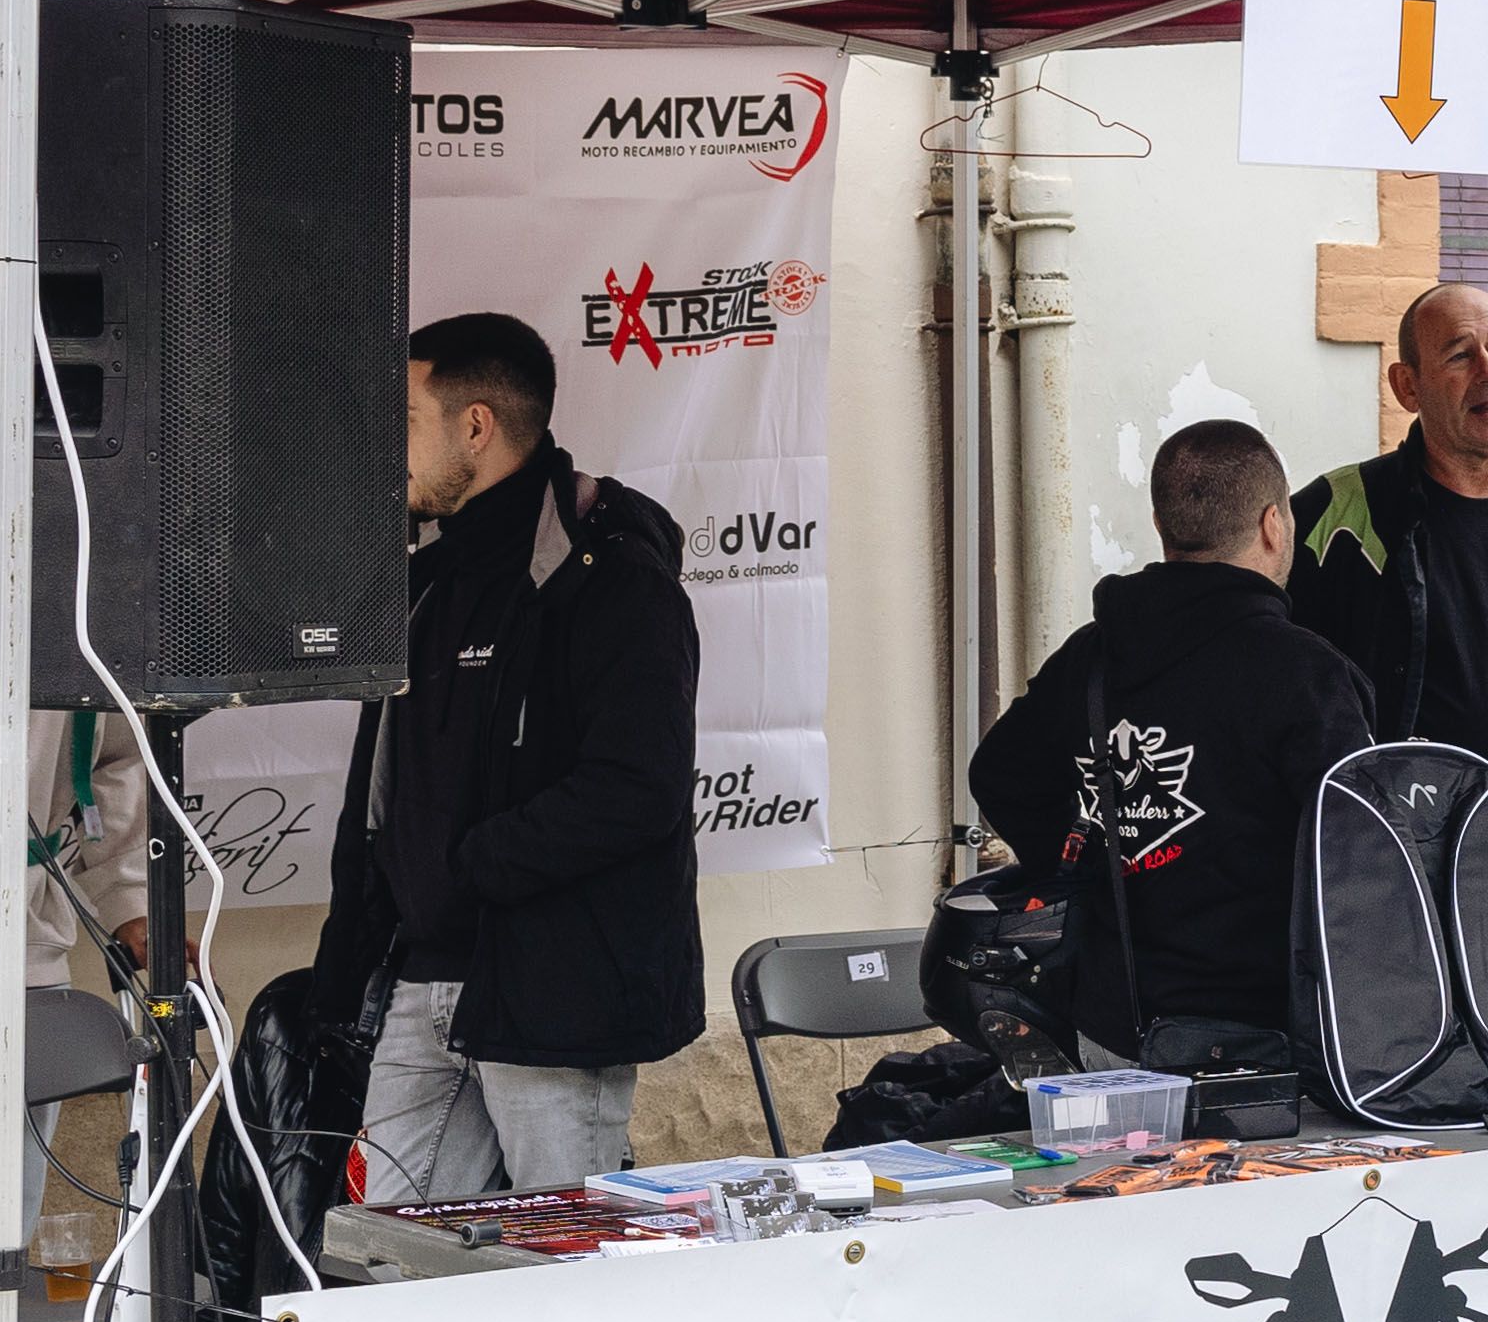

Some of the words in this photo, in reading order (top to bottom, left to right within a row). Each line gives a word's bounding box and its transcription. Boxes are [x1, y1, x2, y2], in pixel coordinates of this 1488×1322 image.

[411, 95, 504, 135] TOS
[582, 94, 795, 140] MARVEA
[418, 142, 504, 158] COLES
[581, 146, 620, 158] MOTO
[623, 144, 685, 158] RECAMBIO
[690, 146, 697, 156] Y
[700, 138, 798, 155] EQUIPAMIENTO
[583, 261, 772, 371] EXTREME
[678, 512, 816, 557] ddVar
[679, 566, 724, 583] odega
[728, 565, 740, 577] &
[743, 563, 799, 578] colmado
[301, 628, 338, 645] QSC
[693, 764, 754, 800] hot
[1124, 794, 1170, 819] riders
[1118, 825, 1139, 837] 020
[1144, 844, 1182, 870] ROAD
[858, 962, 875, 974] 29
